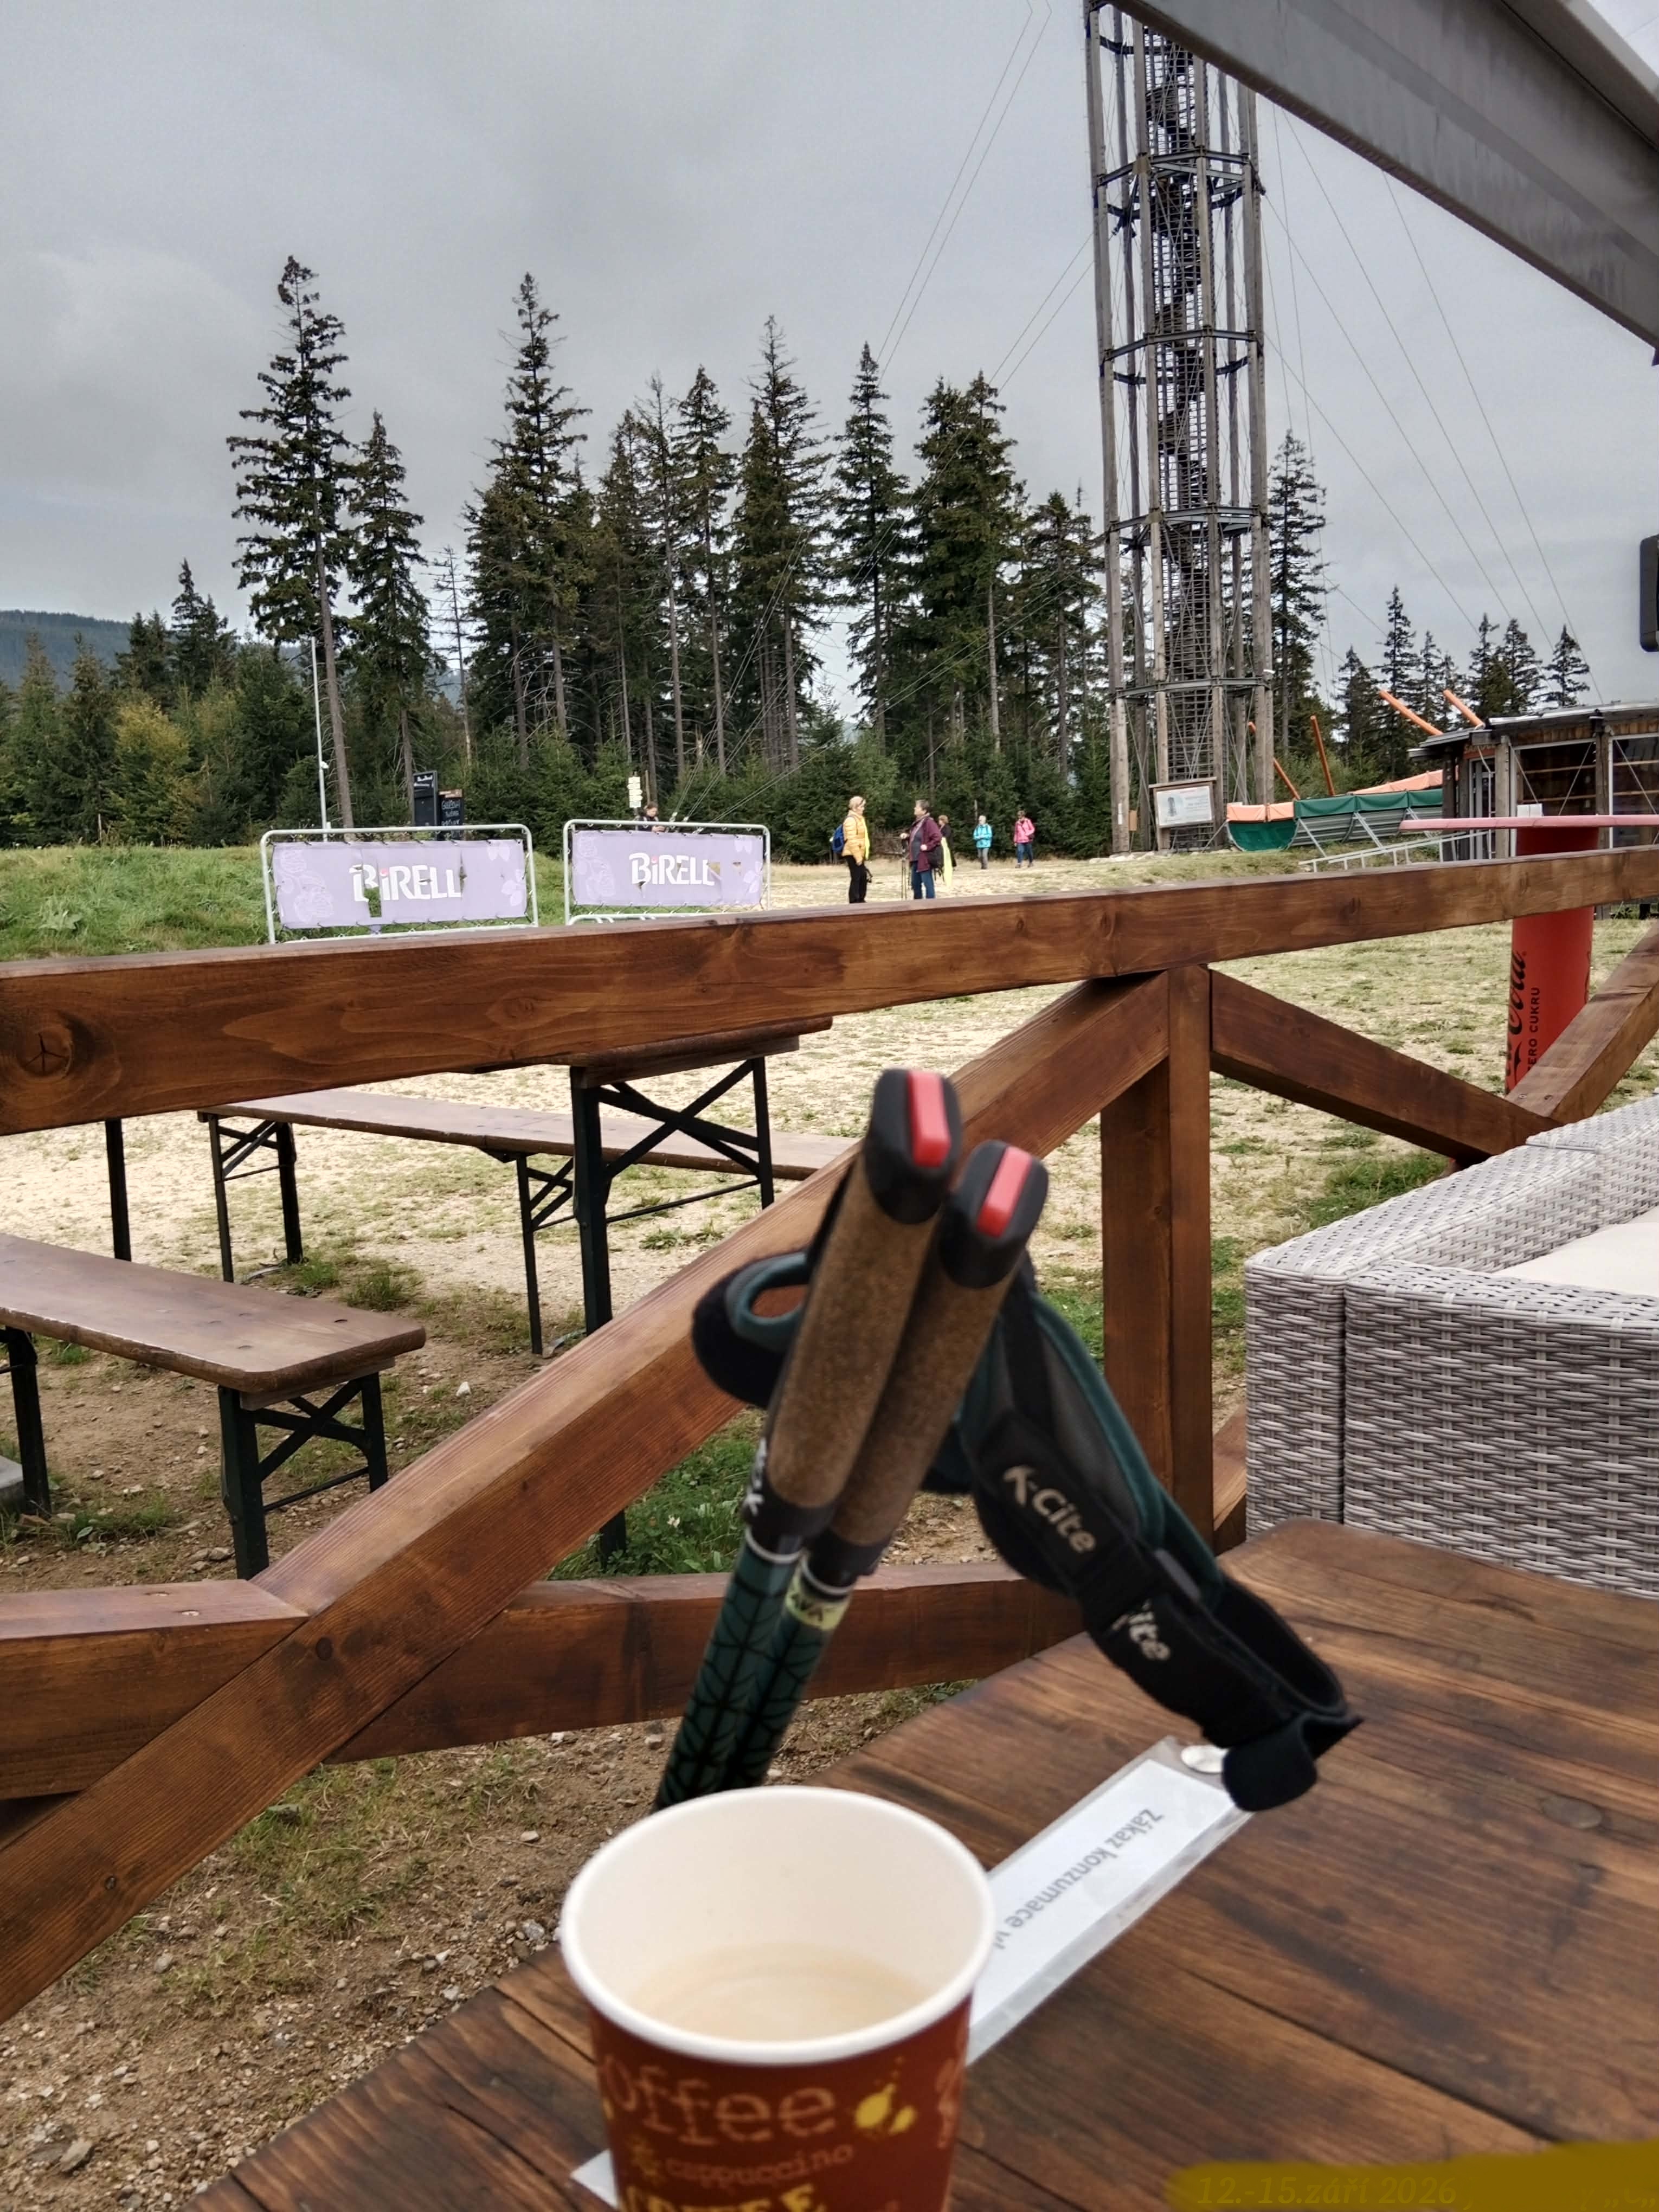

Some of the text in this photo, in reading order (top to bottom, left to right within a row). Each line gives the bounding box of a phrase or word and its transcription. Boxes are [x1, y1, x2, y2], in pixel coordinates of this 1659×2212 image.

[1529, 987, 1540, 1033] CUKRU
[1004, 1808, 1165, 1928] Zákaz konzumace
